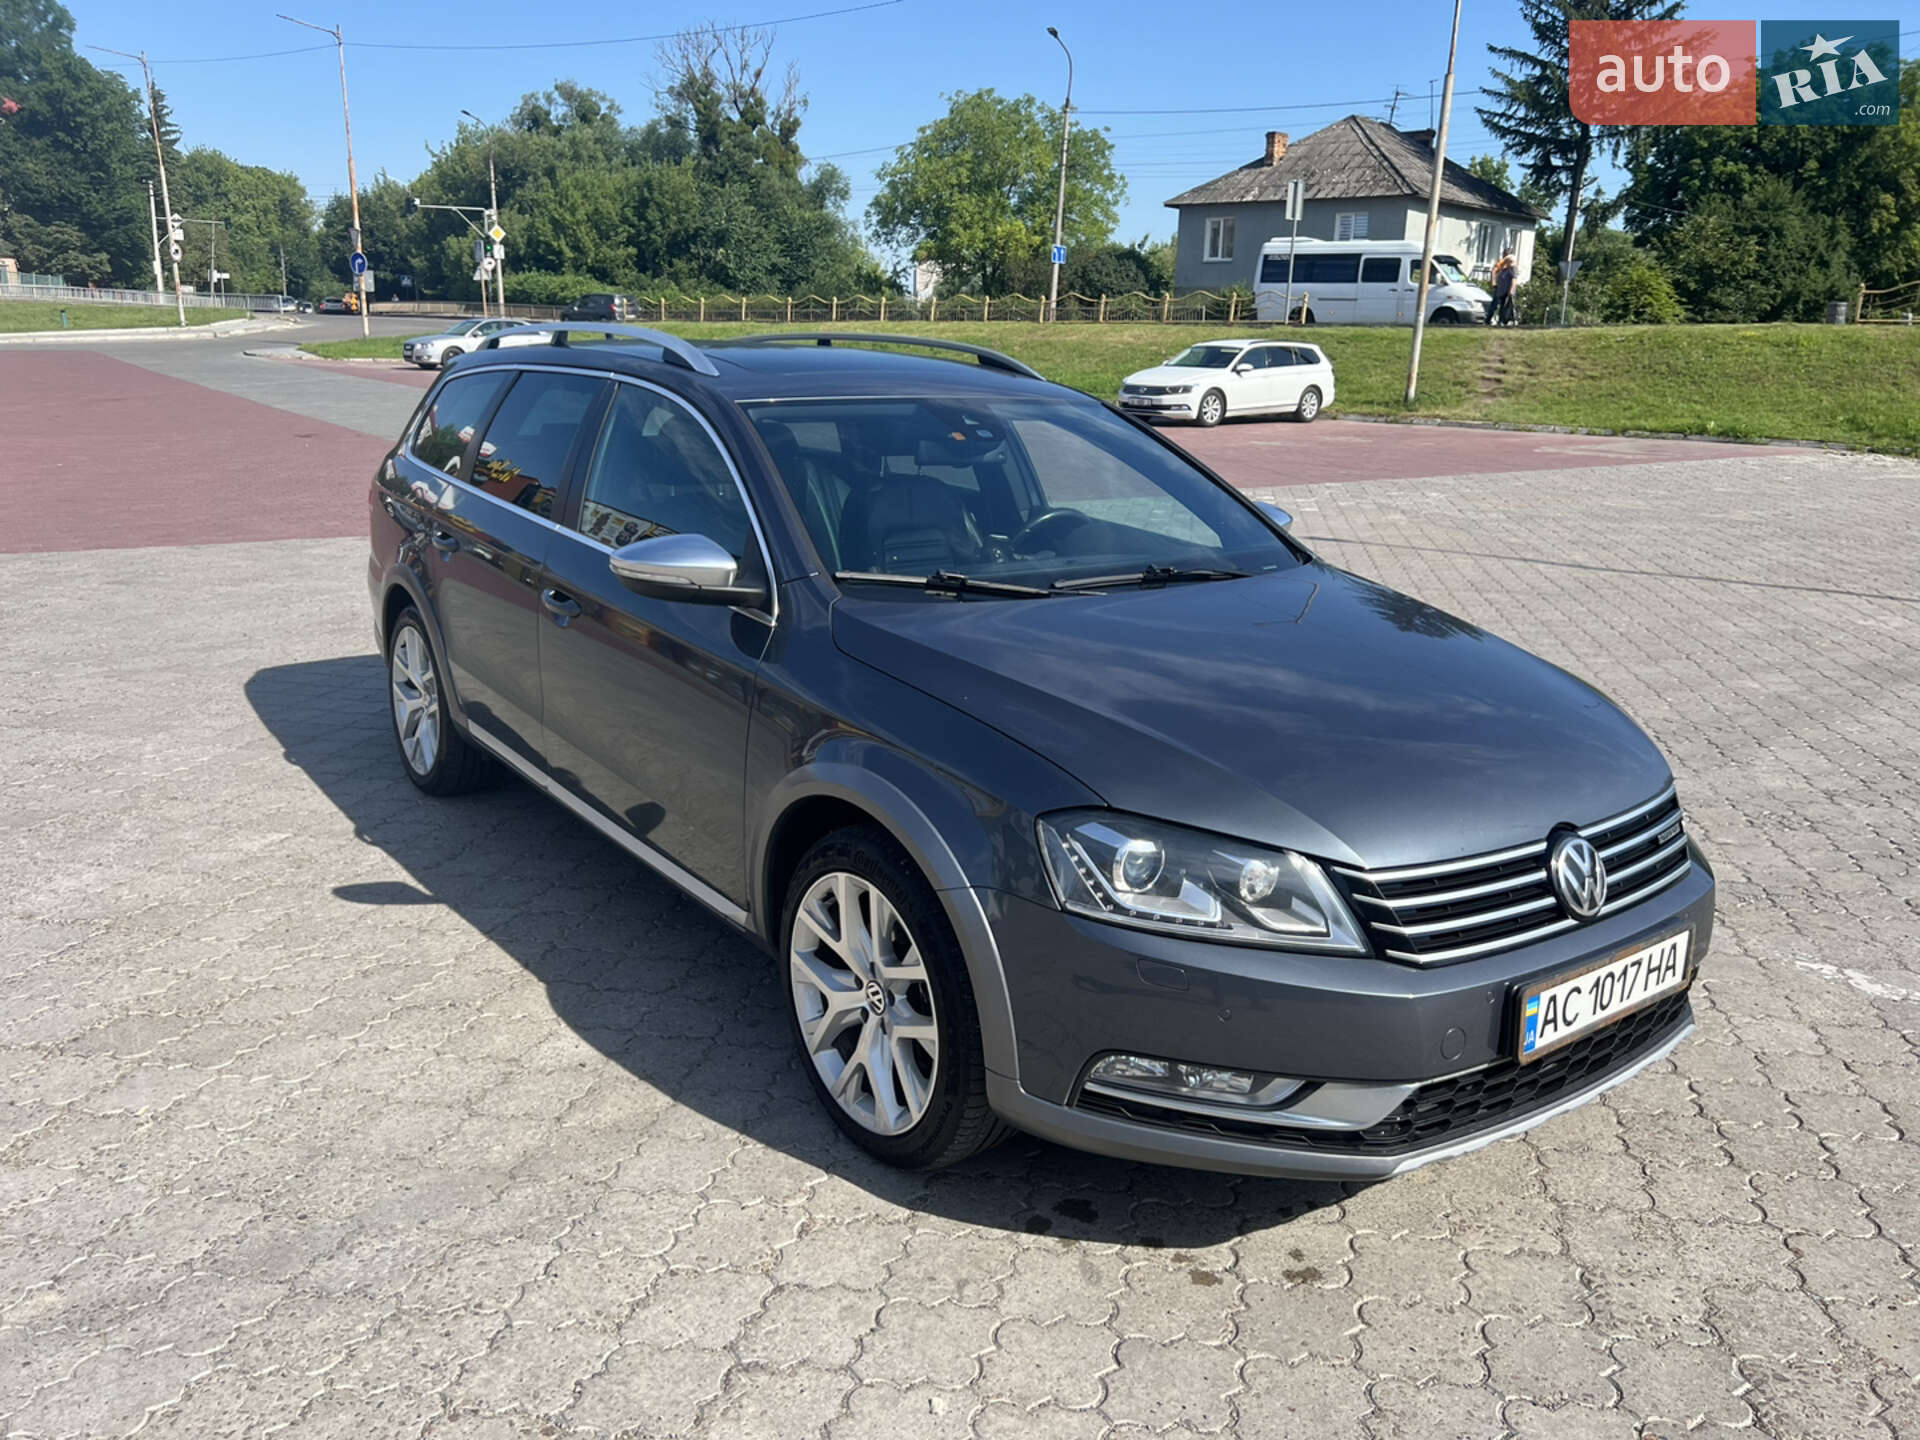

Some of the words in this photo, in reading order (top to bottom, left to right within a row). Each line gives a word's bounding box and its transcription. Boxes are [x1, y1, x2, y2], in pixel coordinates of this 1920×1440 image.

[1539, 986, 1582, 1039] AC
[1588, 958, 1643, 1016] 1017
[1643, 942, 1678, 992] HA
